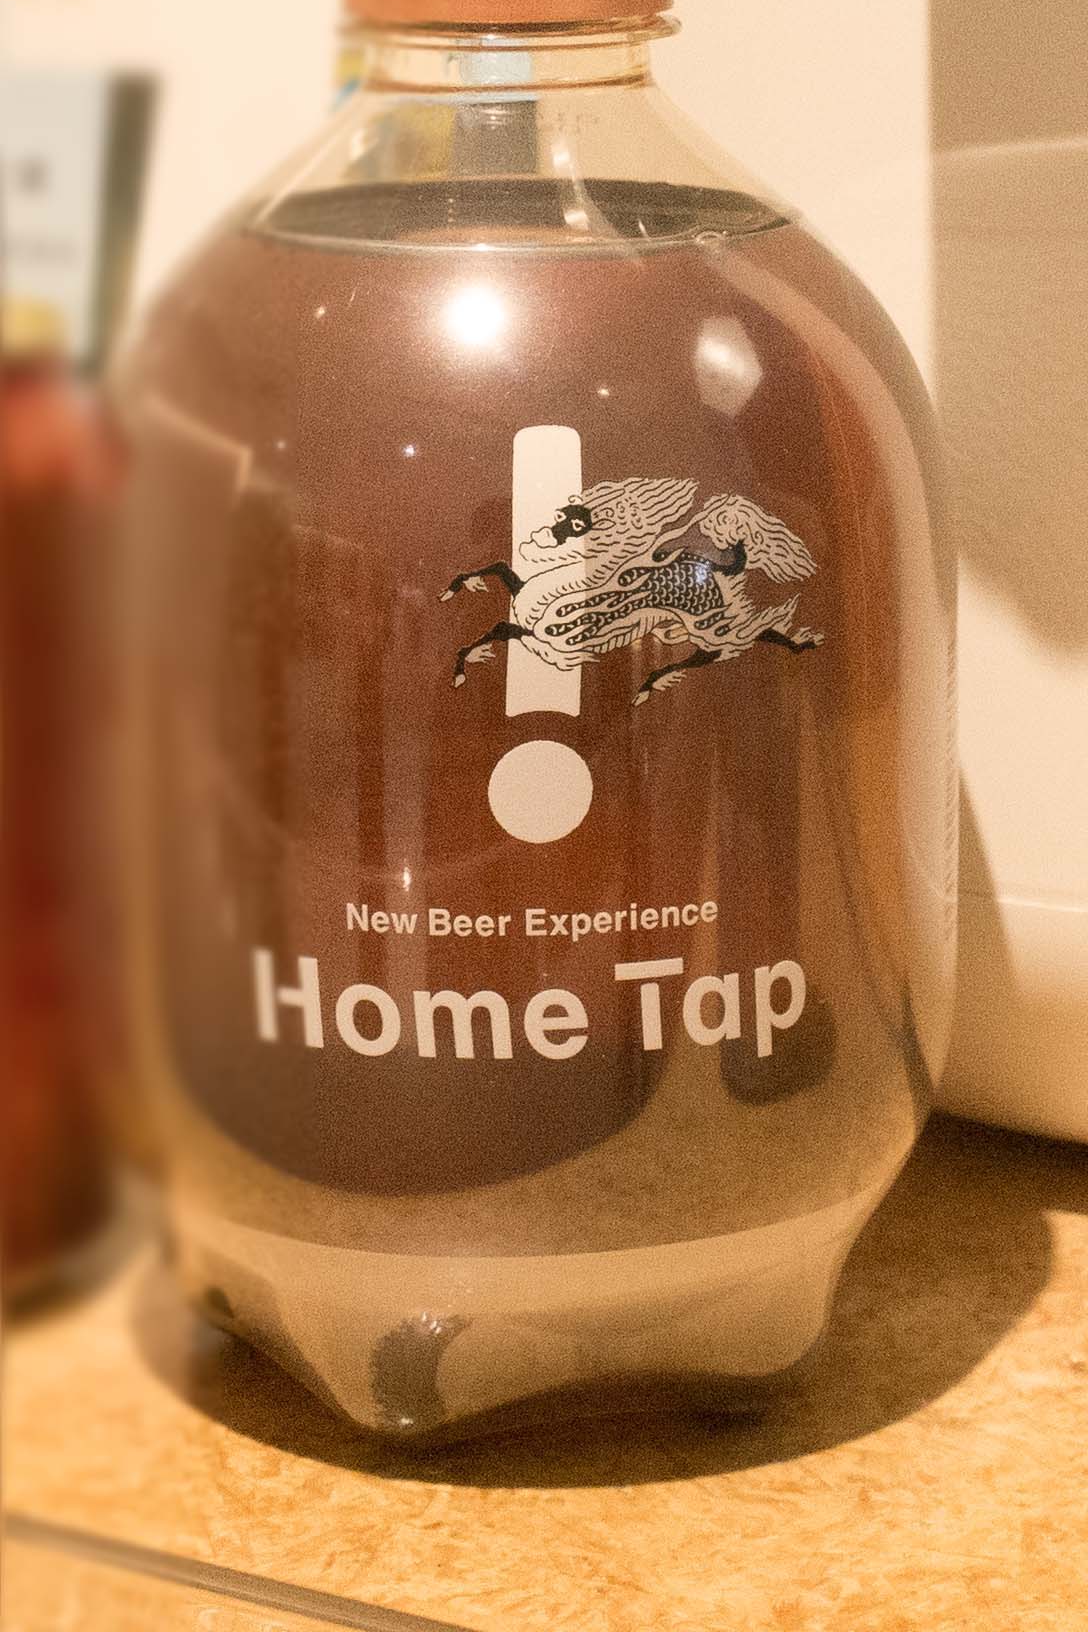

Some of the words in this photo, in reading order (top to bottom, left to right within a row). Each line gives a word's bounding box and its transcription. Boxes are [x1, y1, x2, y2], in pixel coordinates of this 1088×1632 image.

[346, 902, 418, 935] New
[428, 909, 511, 937] Beer
[525, 900, 719, 941] Experience
[252, 947, 590, 1060] Home
[614, 957, 807, 1058] Tap
